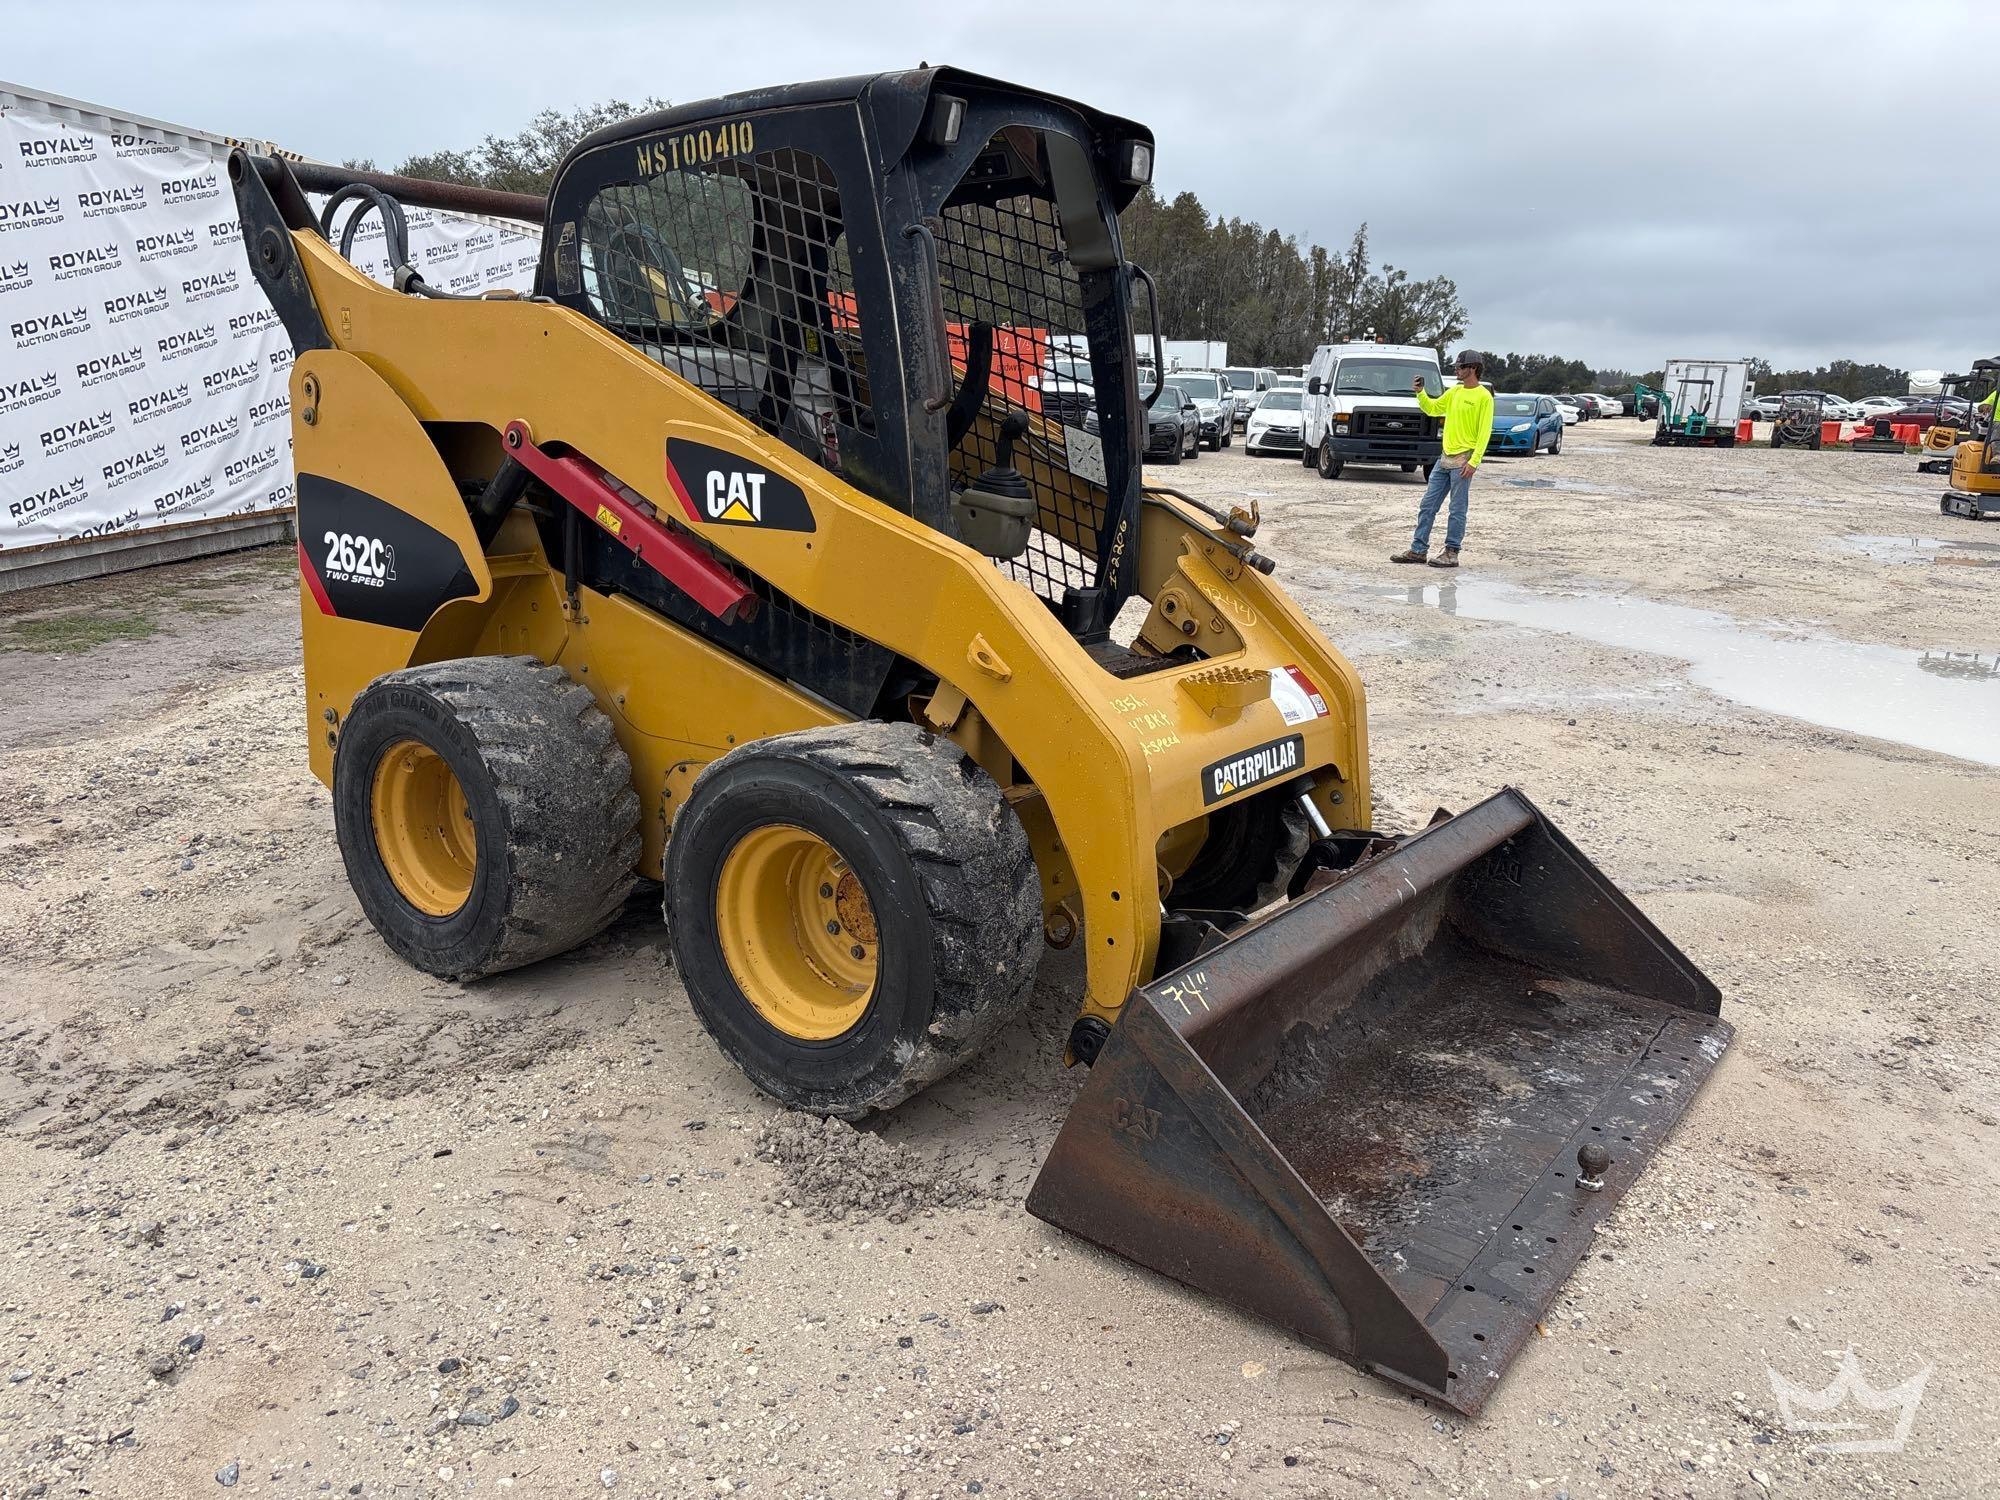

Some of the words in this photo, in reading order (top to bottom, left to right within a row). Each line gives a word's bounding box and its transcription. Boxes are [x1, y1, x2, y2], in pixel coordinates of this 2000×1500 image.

[20, 138, 80, 156] ROYAL
[116, 148, 150, 158] AUCTION
[152, 146, 180, 154] GROUP
[636, 121, 754, 176] MST00410
[25, 156, 67, 168] AUCTION
[68, 154, 97, 163] GROUP
[162, 177, 206, 195] ROYAL
[78, 188, 132, 207] ROYAL
[164, 194, 196, 205] AUCTION
[197, 190, 219, 199] GROUP
[0, 201, 45, 220] OYAL
[83, 206, 120, 218] AUCTION
[121, 202, 147, 212] GROUP
[405, 212, 425, 224] OYAL
[0, 220, 30, 232] CTION
[31, 215, 64, 226] GROUP
[209, 220, 242, 237] ROYA
[136, 232, 183, 252] ROYAL
[426, 245, 452, 257] ROYAL
[466, 235, 487, 248] ROYAL
[49, 248, 106, 270] ROYAL
[140, 250, 172, 262] AUCTION
[173, 244, 198, 256] GROUP
[518, 256, 536, 267] ROYAL
[55, 267, 93, 281] AUCTION
[94, 261, 122, 272] GROUP
[450, 275, 474, 288] ROYAL
[486, 265, 507, 277] ROYAL
[182, 273, 226, 294] ROYAL
[186, 291, 215, 303] AUCTION
[217, 284, 239, 295] GROUP
[104, 291, 154, 314] ROYAL
[109, 310, 142, 324] AUCTION
[144, 302, 169, 315] GROUP
[11, 312, 73, 338] ROYAL
[229, 309, 271, 330] ROYAL
[17, 332, 58, 349] AUCTION
[60, 324, 91, 338] GROUP
[158, 328, 204, 352] ROYAL
[233, 327, 263, 339] AUCTION
[162, 346, 194, 362] AUCTION
[194, 339, 218, 352] GROUP
[269, 347, 295, 365] ROY
[77, 352, 130, 378] ROYAL
[81, 371, 118, 388] AUCTION
[119, 362, 146, 376] GROUP
[203, 364, 248, 388] ROYAL
[28, 388, 61, 405] GROUP
[206, 382, 237, 398] AUCTION
[238, 373, 259, 386] GROUP
[129, 389, 178, 415] ROYAL
[133, 407, 166, 425] AUCTION
[167, 398, 192, 412] GROUP
[249, 397, 289, 419] ROYAL
[253, 412, 279, 427] AUCTION
[40, 418, 99, 447] ROYAL
[46, 437, 85, 457] AUCTION
[87, 426, 116, 442] GROUP
[181, 421, 227, 447] ROYAL
[185, 438, 216, 456] AUCTION
[217, 430, 240, 444] GROUP
[0, 459, 24, 474] ROUP
[103, 451, 154, 479] ROYAL
[108, 470, 142, 490] AUCTION
[142, 458, 169, 474] GROUP
[225, 451, 266, 478] ROYAL
[228, 470, 257, 487] AUCTION
[257, 459, 279, 472] GROUP
[9, 485, 70, 518] ROYAL
[154, 482, 201, 511] ROYAL
[157, 501, 191, 519] AUCTION
[192, 489, 215, 504] GROUP
[269, 483, 293, 504] ROY
[706, 470, 766, 522] CAT
[17, 506, 55, 528] AUCTION
[57, 492, 88, 510] GROUP
[326, 570, 349, 581] TWO
[350, 574, 384, 588] SPEED
[390, 691, 439, 720] GUARD
[1214, 740, 1296, 796] CATERPILLAR
[1112, 1096, 1162, 1140] CAT
